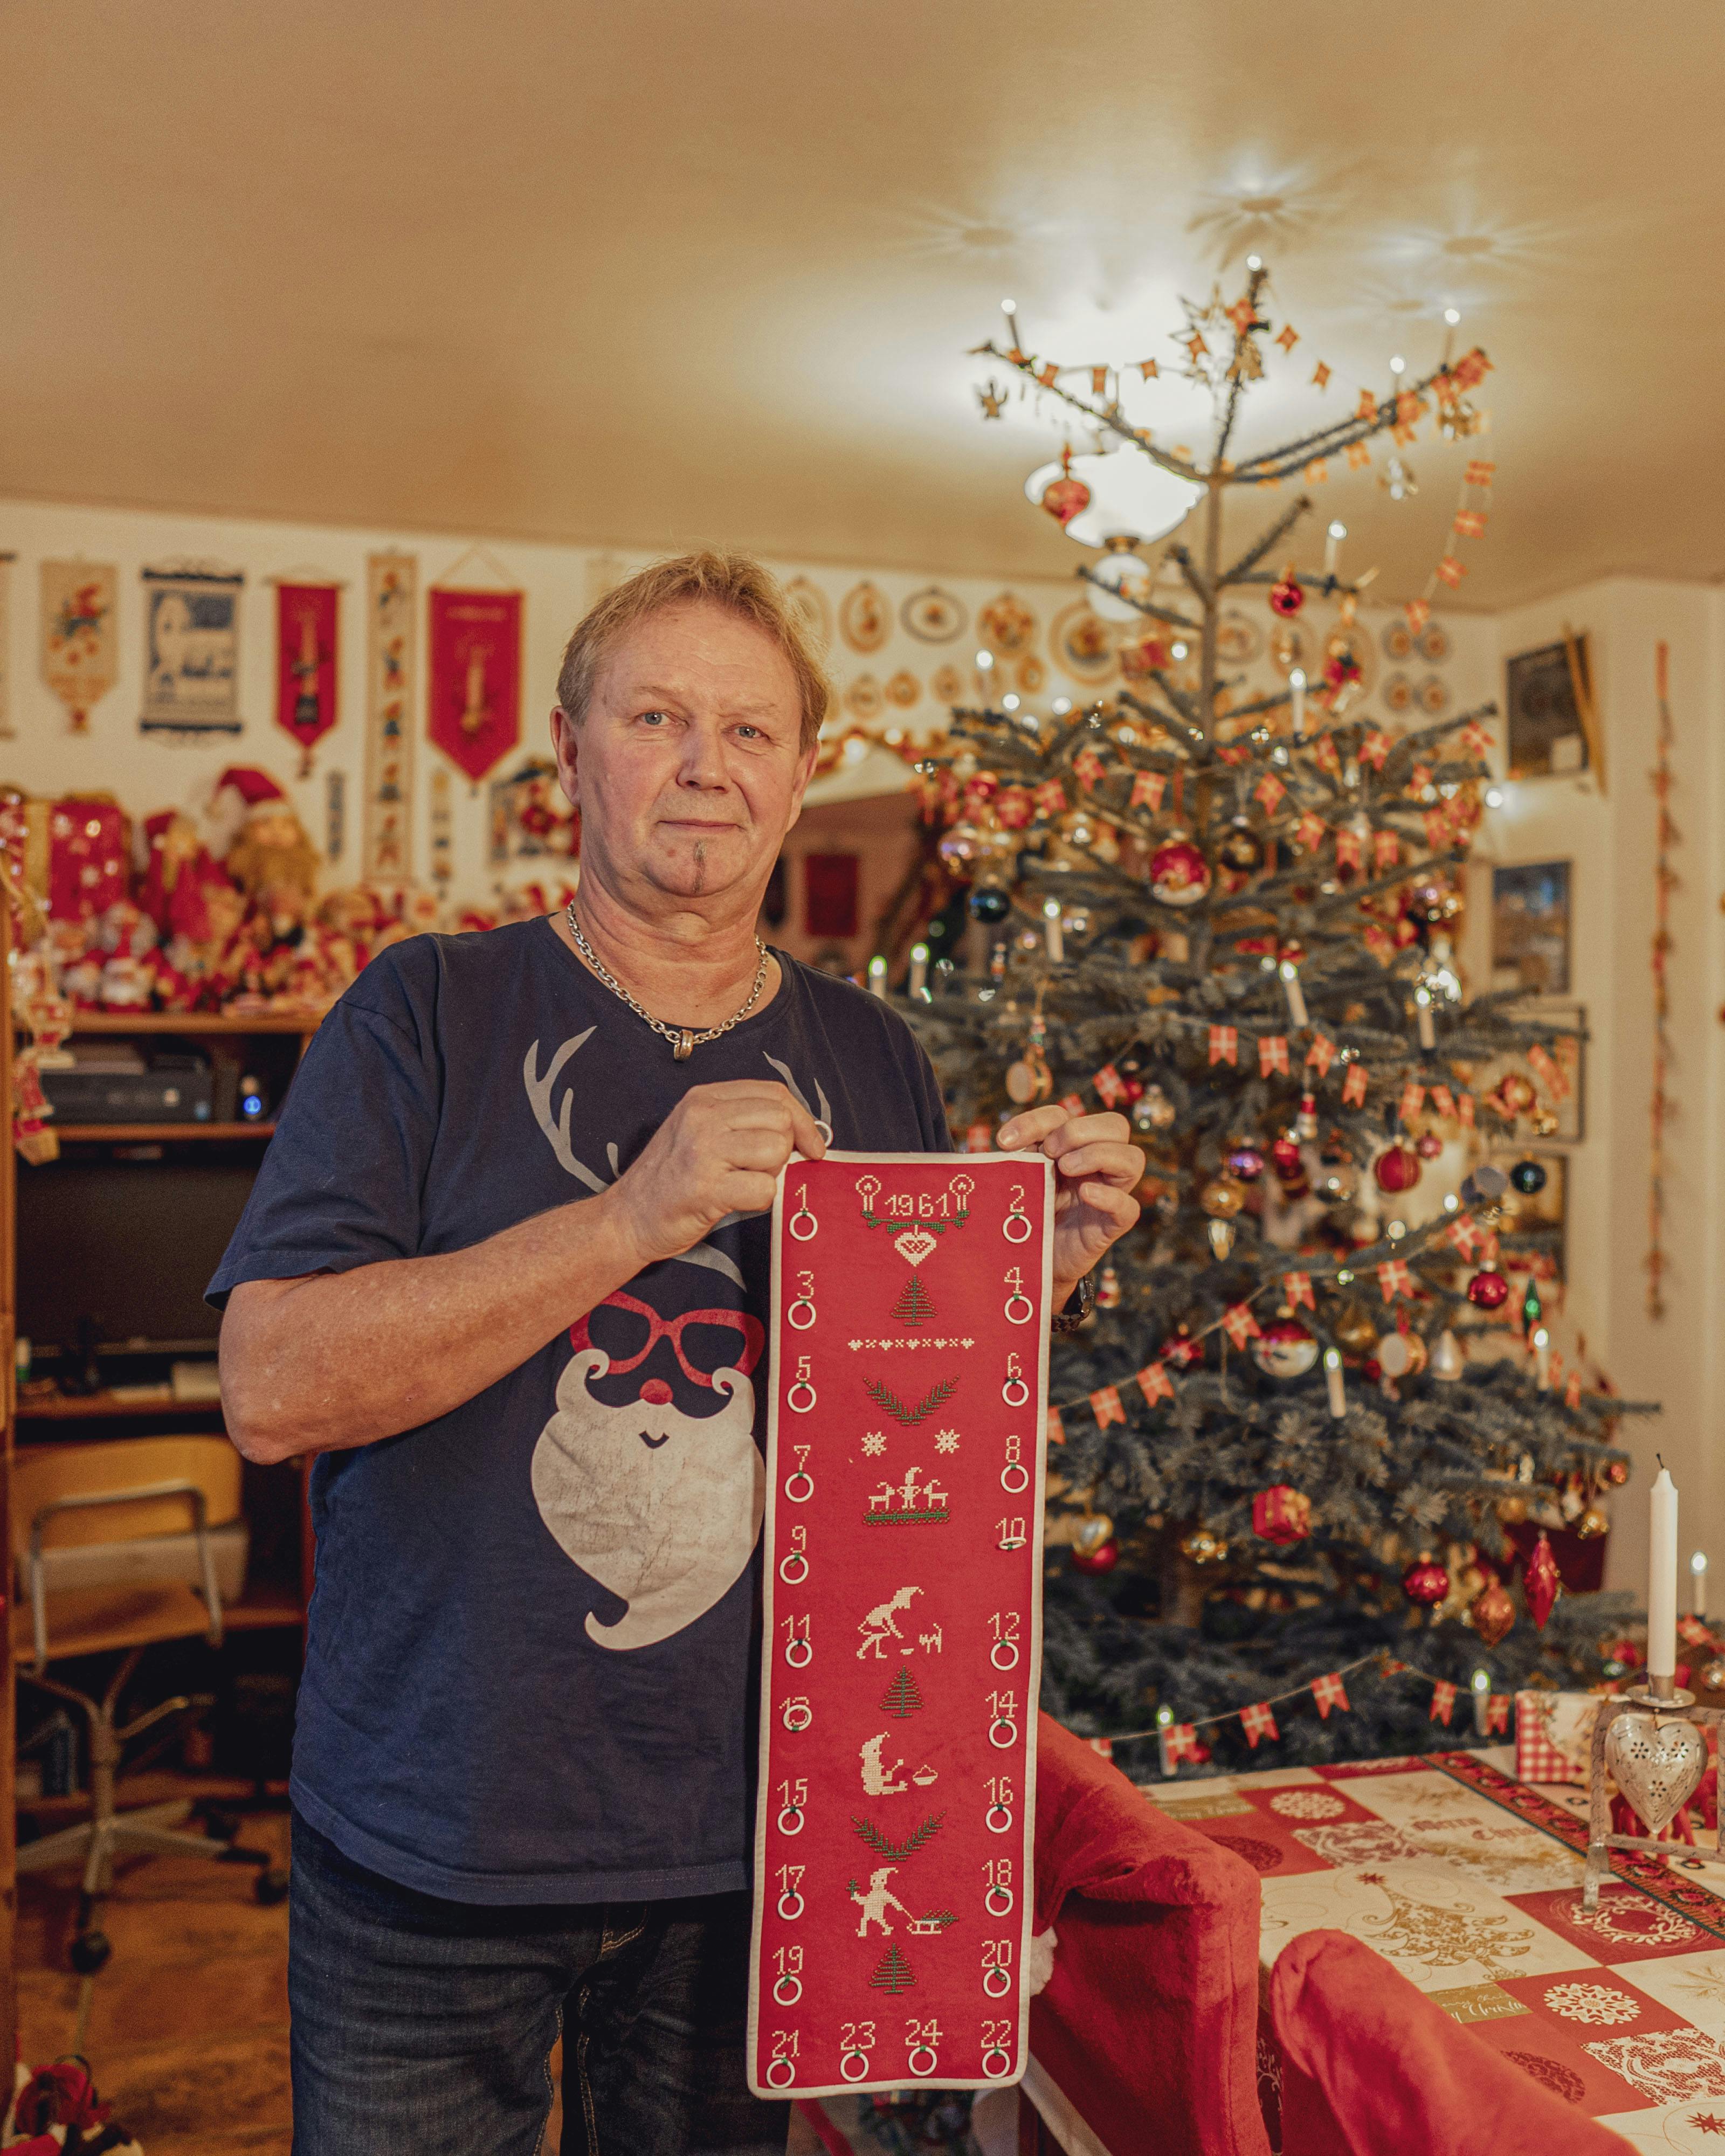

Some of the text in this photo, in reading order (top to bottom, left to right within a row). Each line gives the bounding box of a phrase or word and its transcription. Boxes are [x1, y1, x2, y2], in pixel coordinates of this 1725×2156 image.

[795, 1184, 807, 1211] 1
[884, 1193, 949, 1217] 1961
[1010, 1185, 1024, 1213] 2
[796, 1270, 814, 1299] 3
[1004, 1267, 1024, 1294] 4
[796, 1356, 811, 1381] 5
[1007, 1353, 1022, 1379] 6
[794, 1444, 811, 1473] 7
[1006, 1435, 1020, 1463] 8
[790, 1525, 806, 1553] 9
[995, 1517, 1025, 1544] 10
[781, 1614, 810, 1641] 11
[987, 1612, 1019, 1640] 12
[985, 1690, 1018, 1718] 14
[777, 1778, 808, 1807] 15
[983, 1777, 1013, 1805] 16
[775, 1864, 806, 1892] 17
[982, 1858, 1012, 1887] 18
[772, 1945, 803, 1975] 19
[981, 1939, 1012, 1967] 20
[771, 2029, 800, 2058] 21
[840, 2021, 875, 2050] 23
[905, 2019, 943, 2047] 24
[981, 2020, 1011, 2048] 22
